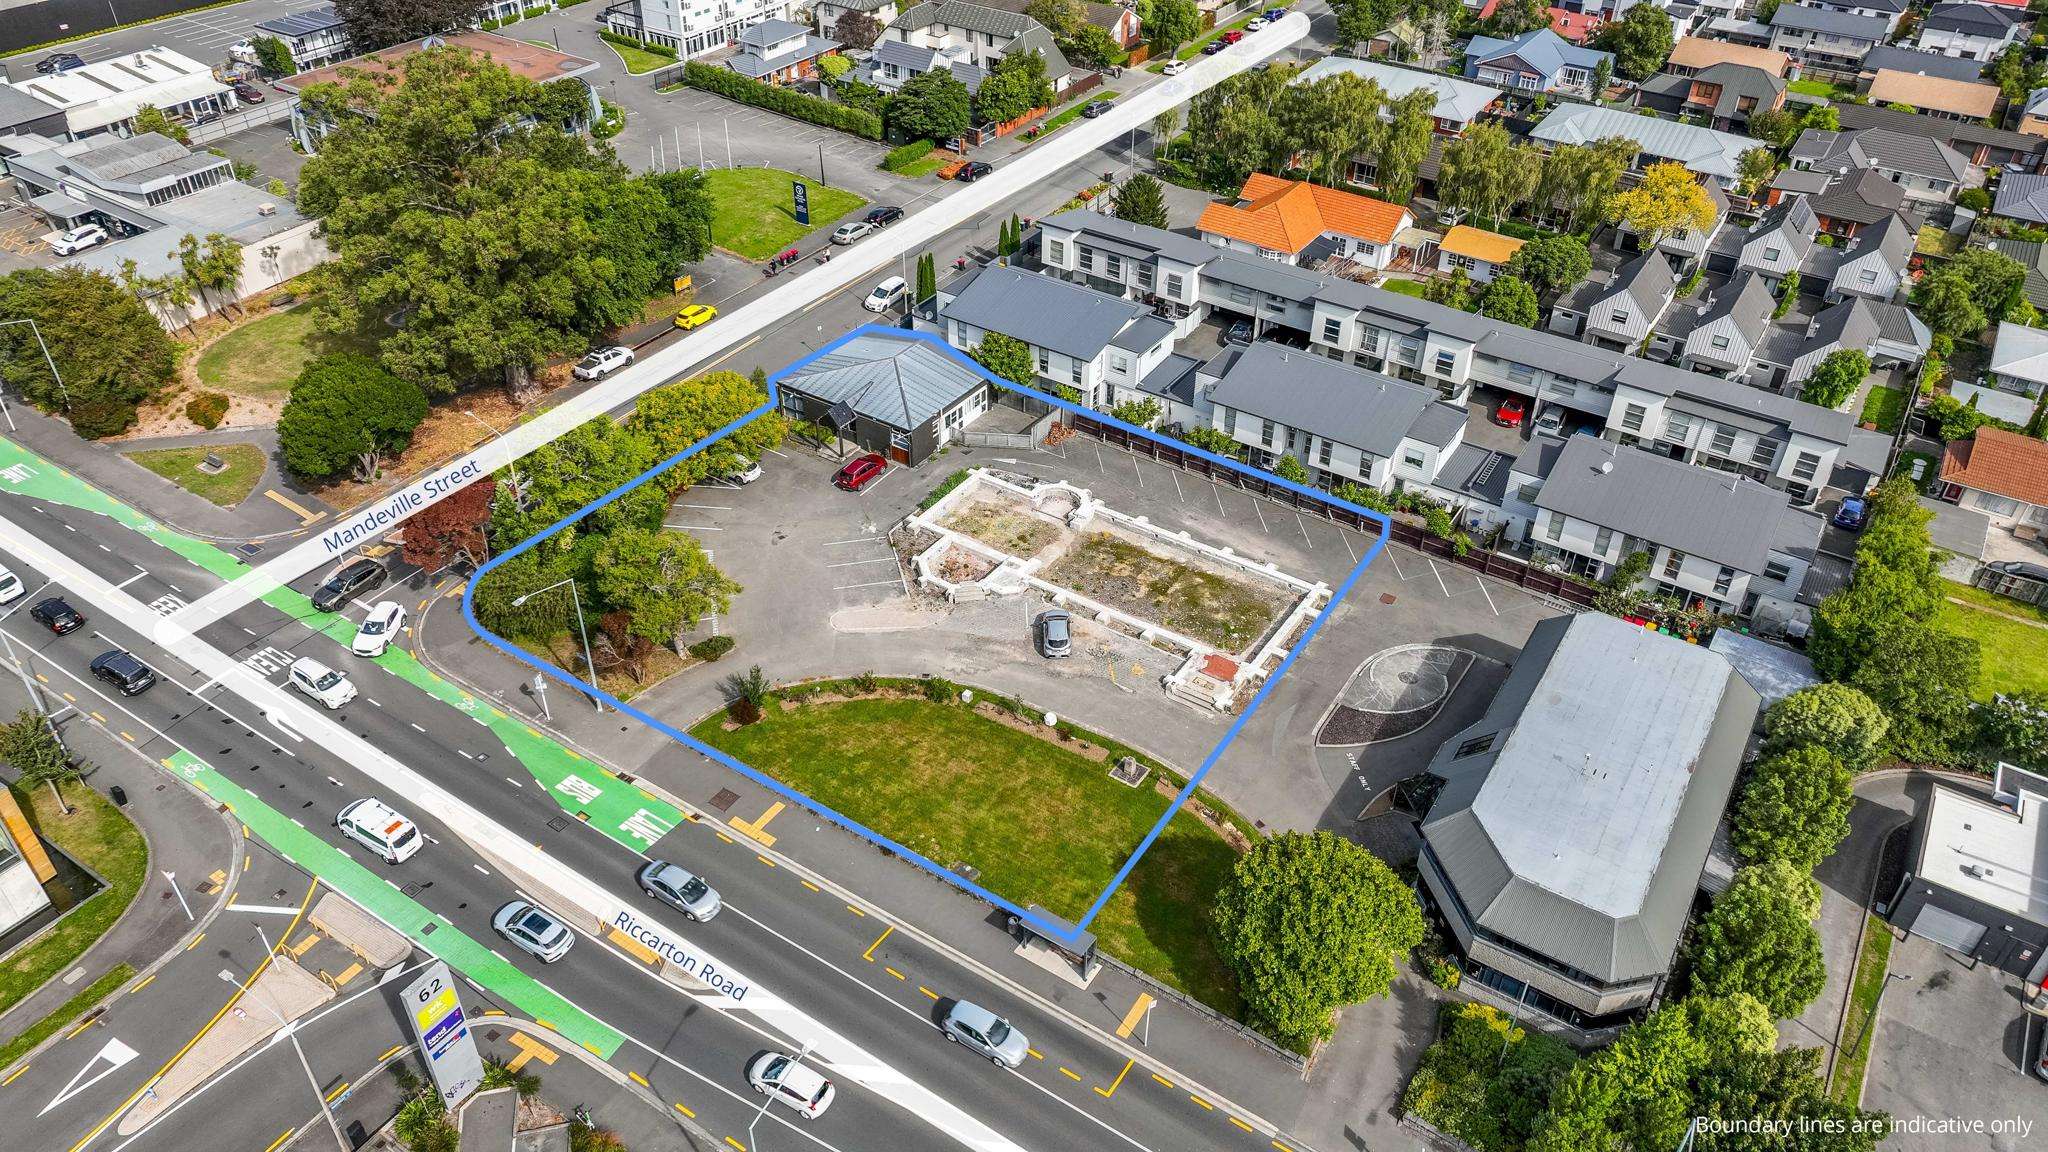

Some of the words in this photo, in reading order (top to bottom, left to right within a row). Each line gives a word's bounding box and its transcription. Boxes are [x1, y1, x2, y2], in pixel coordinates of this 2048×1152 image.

[238, 646, 294, 678] CLEA
[618, 808, 675, 847] LANE
[419, 978, 443, 1003] 62
